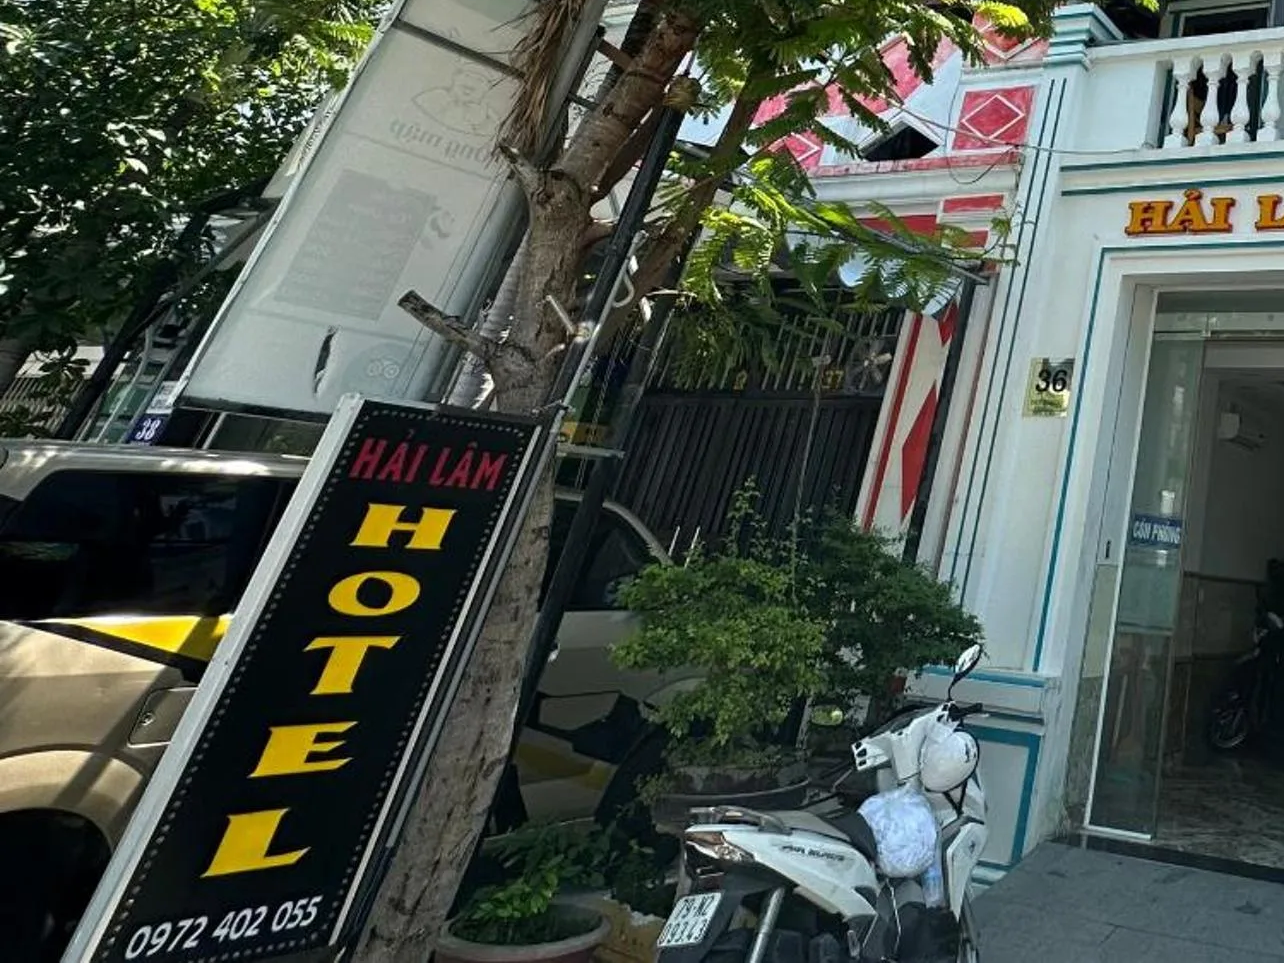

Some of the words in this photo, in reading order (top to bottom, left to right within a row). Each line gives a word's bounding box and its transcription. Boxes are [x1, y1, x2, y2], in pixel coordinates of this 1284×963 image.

[1125, 189, 1236, 235] HẢI
[1035, 369, 1067, 392] 36
[134, 417, 161, 441] 38
[348, 429, 429, 483] HẢI
[428, 440, 508, 490] LÂM
[200, 502, 457, 878] HOTEL
[124, 915, 209, 960] 0972
[212, 905, 268, 942] 402
[270, 894, 324, 932] 055
